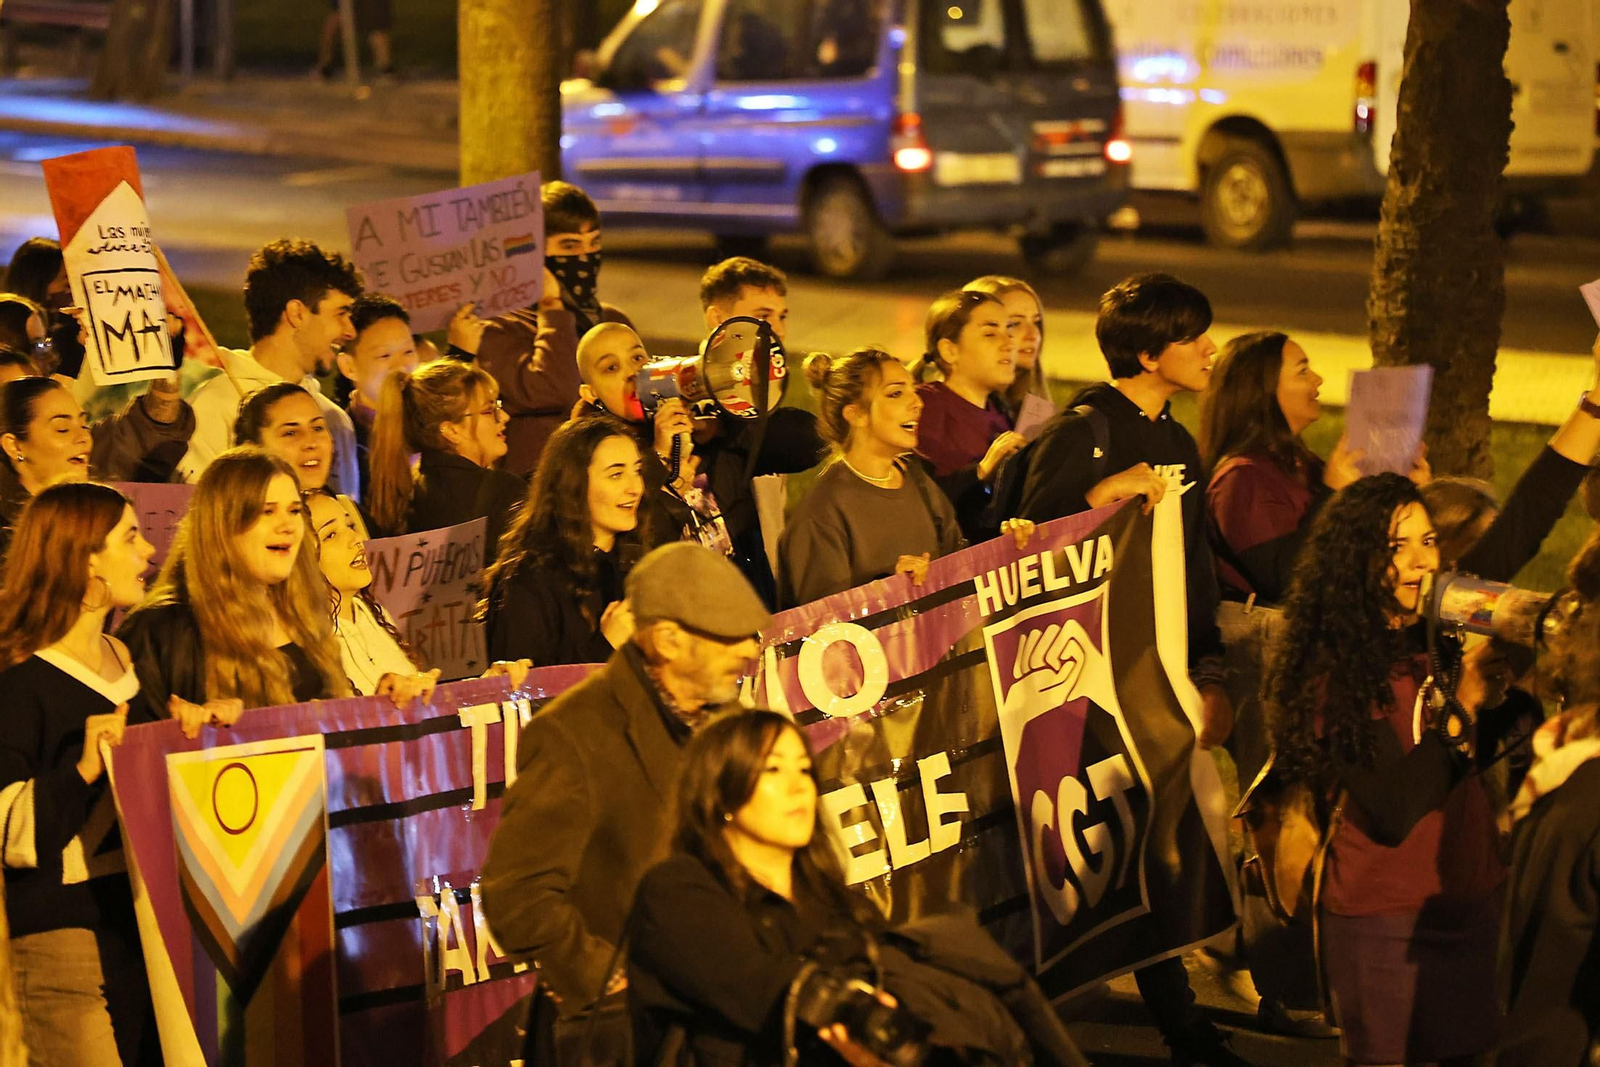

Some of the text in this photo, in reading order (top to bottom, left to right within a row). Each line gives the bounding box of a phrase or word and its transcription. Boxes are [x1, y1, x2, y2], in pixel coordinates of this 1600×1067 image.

[354, 214, 384, 251] A
[397, 202, 442, 242] MI
[469, 237, 500, 269] LAS
[93, 279, 114, 294] EL
[973, 534, 1115, 618] HUELVA
[817, 750, 970, 887] ELE
[1030, 752, 1138, 927] CGT
